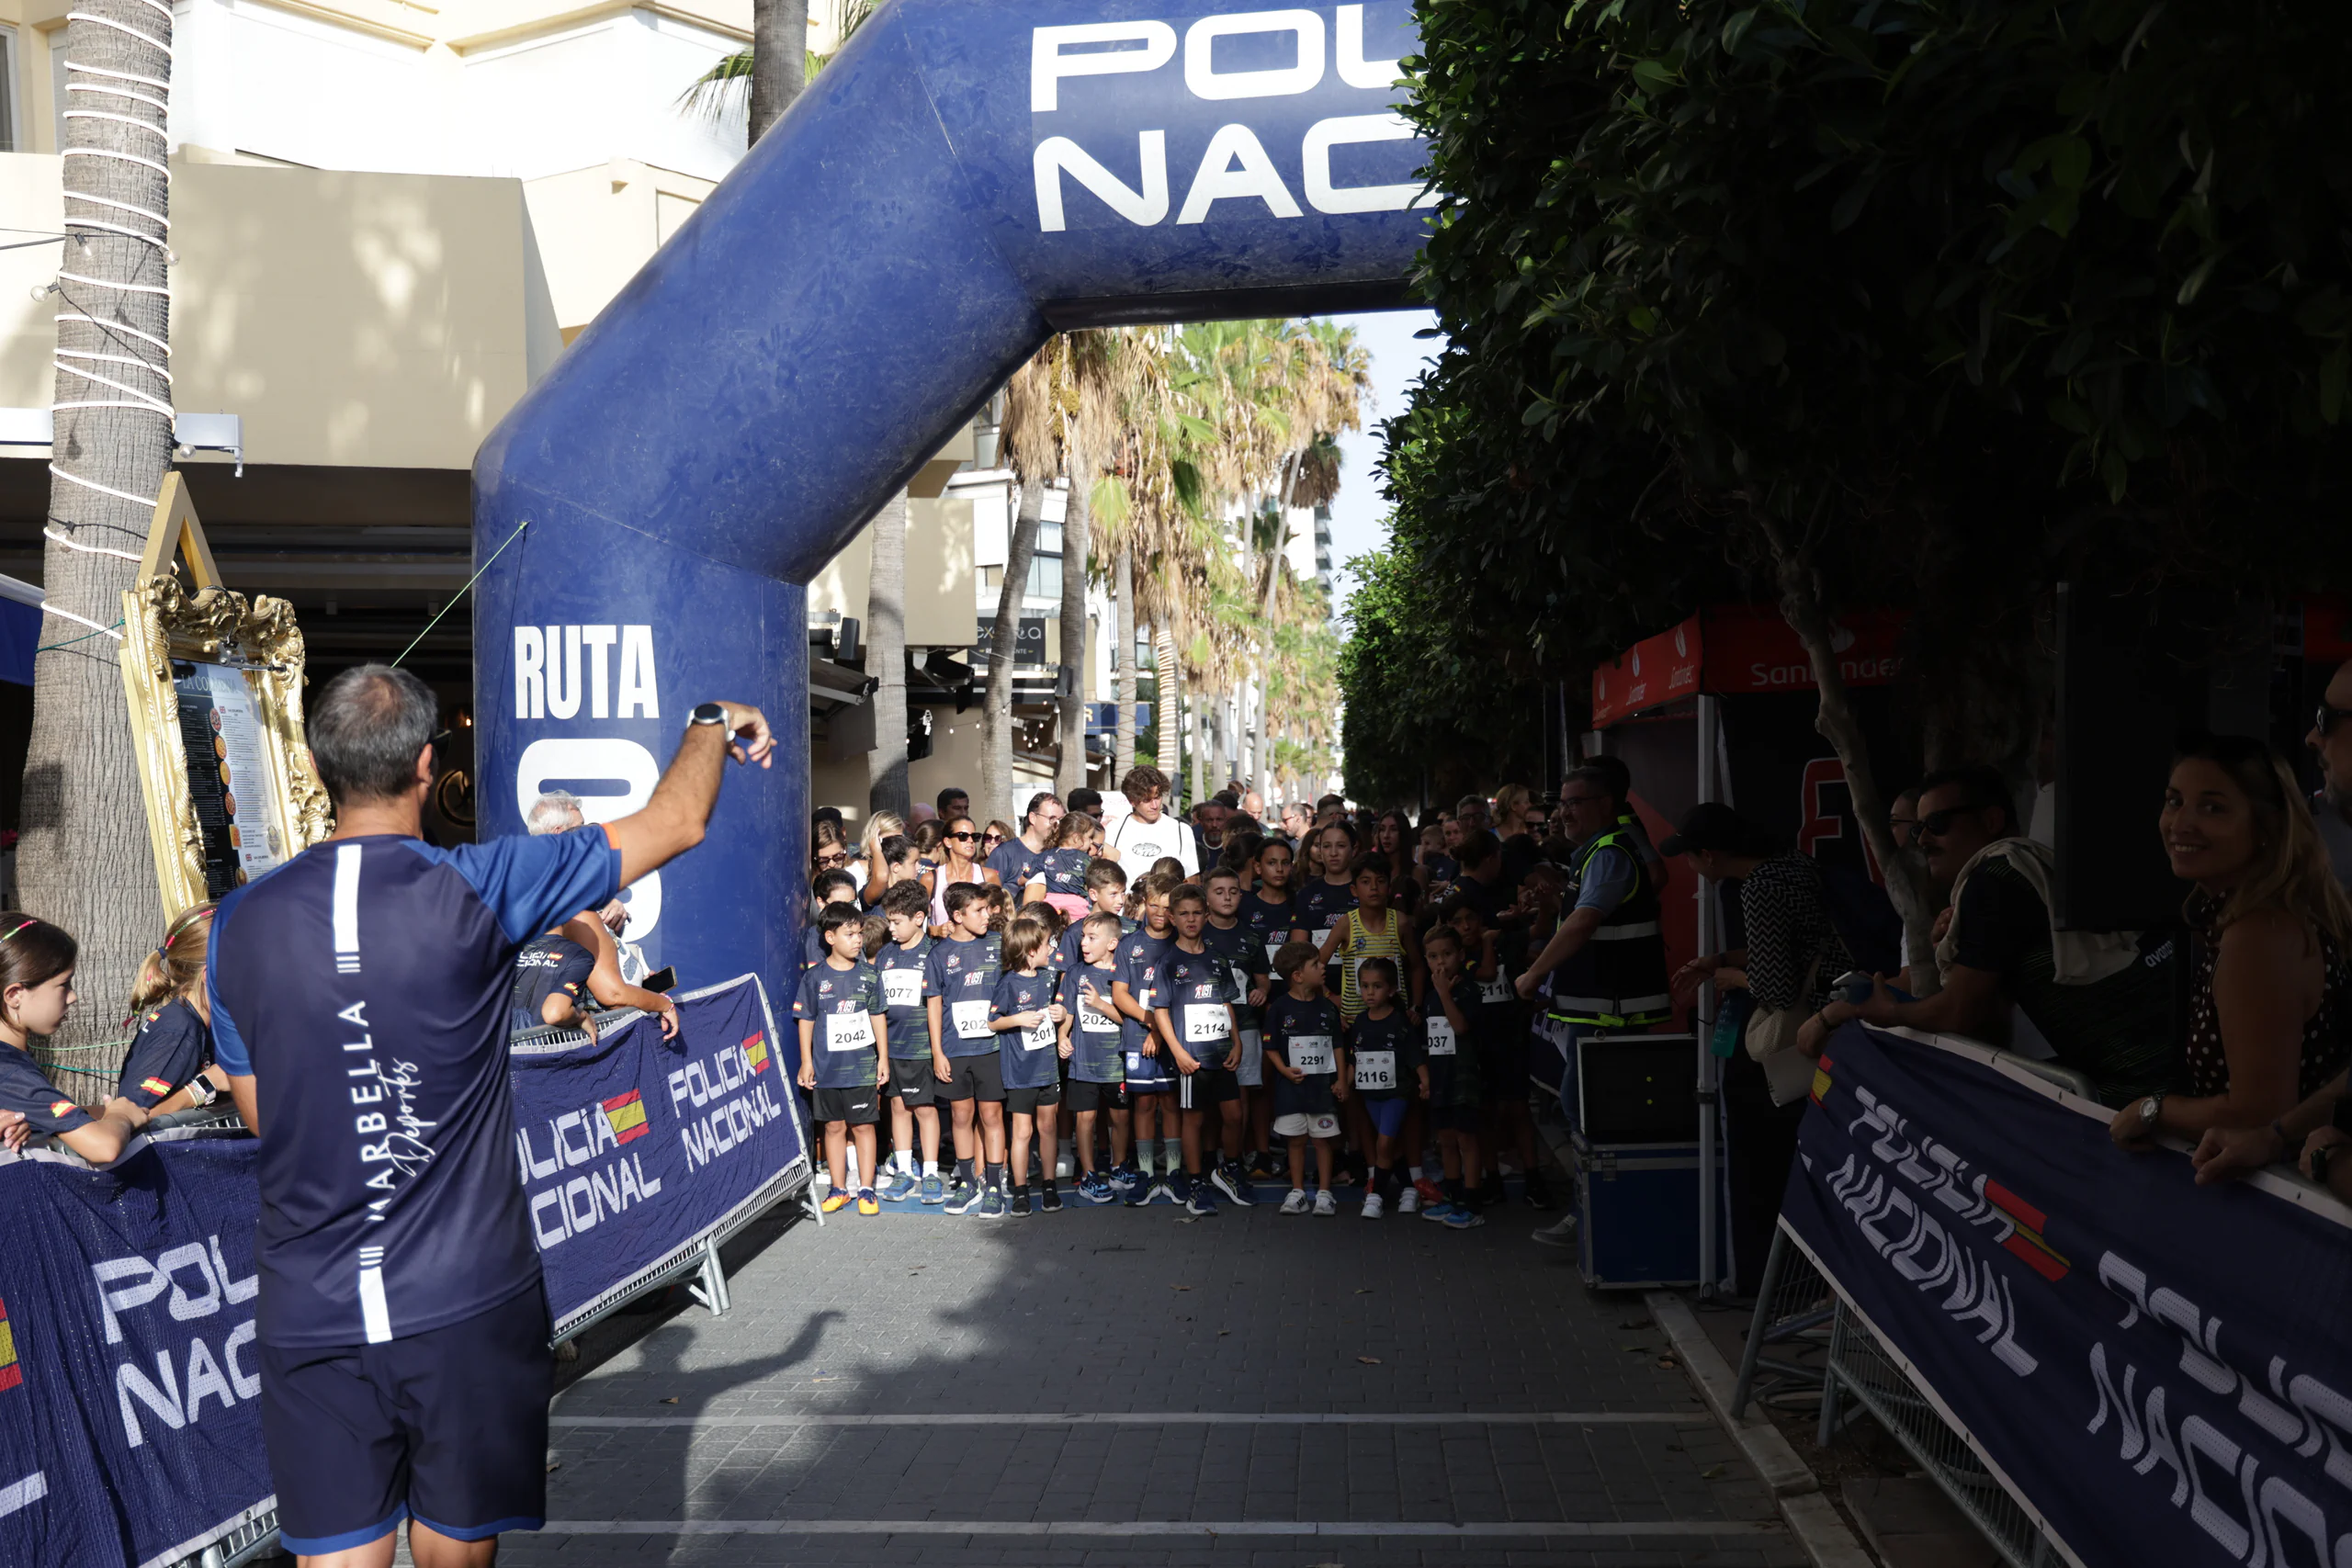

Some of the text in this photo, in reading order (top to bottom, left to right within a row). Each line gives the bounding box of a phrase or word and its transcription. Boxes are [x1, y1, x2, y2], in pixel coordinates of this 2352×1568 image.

[1031, 4, 1431, 112] POL
[1033, 112, 1444, 232] NAC
[514, 625, 660, 720] RUTA
[834, 1029, 866, 1044] 2042
[885, 987, 913, 998] 2077
[961, 1019, 988, 1032] 202
[1193, 1022, 1226, 1035] 2114
[1300, 1055, 1325, 1066] 2291
[1358, 1070, 1388, 1083] 2116
[1427, 1035, 1448, 1048] 037
[378, 1057, 437, 1178] Deportes
[514, 1101, 621, 1185] LICÍA
[682, 1081, 782, 1173] NACIONAL
[531, 1152, 662, 1253] CIONAL
[92, 1234, 260, 1346] POL
[1826, 1154, 2039, 1378] NACIONAL
[117, 1319, 263, 1449] NAC
[2098, 1250, 2352, 1492] POLIC
[2086, 1342, 2352, 1568] NACIO
